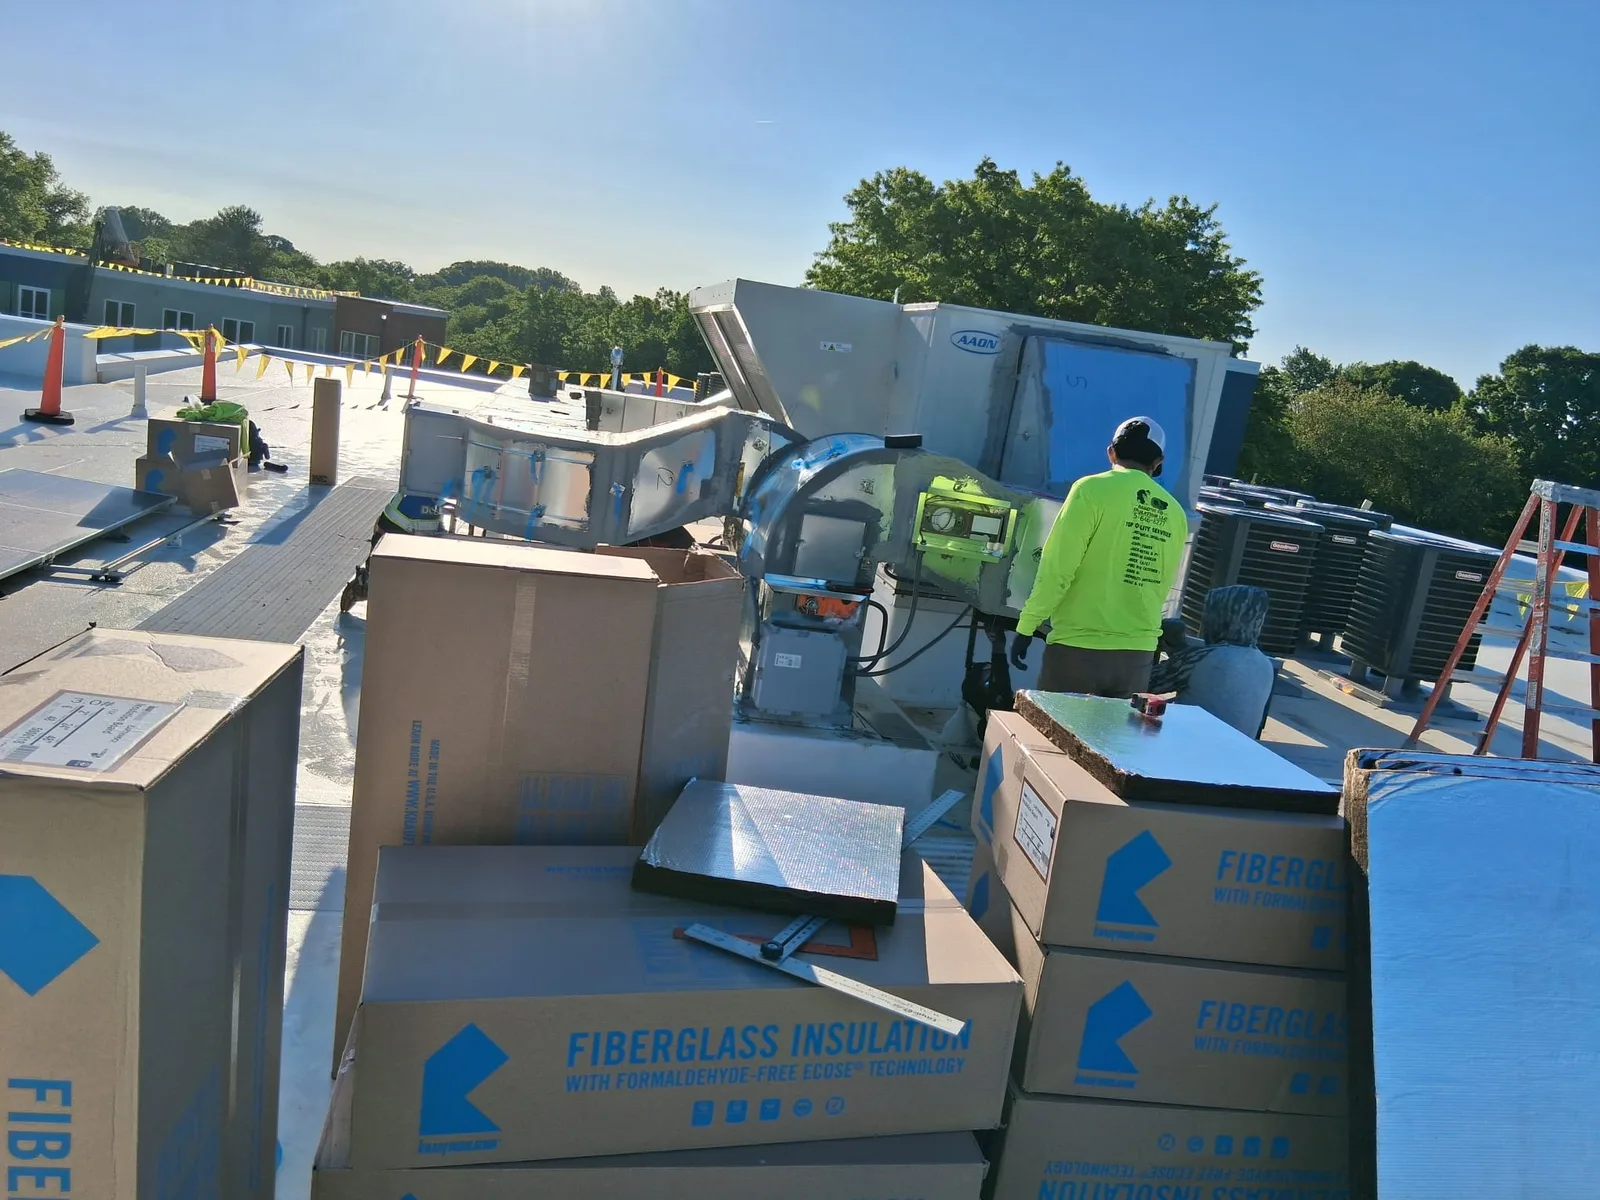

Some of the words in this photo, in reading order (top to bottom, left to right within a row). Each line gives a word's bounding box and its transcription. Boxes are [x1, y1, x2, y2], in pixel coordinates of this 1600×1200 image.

[957, 335, 997, 349] AAON
[1214, 886, 1249, 906] WITH
[567, 1024, 780, 1068] FIBERGLASS
[791, 1017, 973, 1057] INSULATION
[1194, 1036, 1230, 1054] WITH
[565, 1073, 611, 1092] WITH
[616, 1064, 798, 1090] FORMALDEHYDE-FREE
[869, 1057, 965, 1077] TECHNOLOGY
[8, 1078, 72, 1200] FIBE
[1044, 1160, 1134, 1179] TECHNOLOGY
